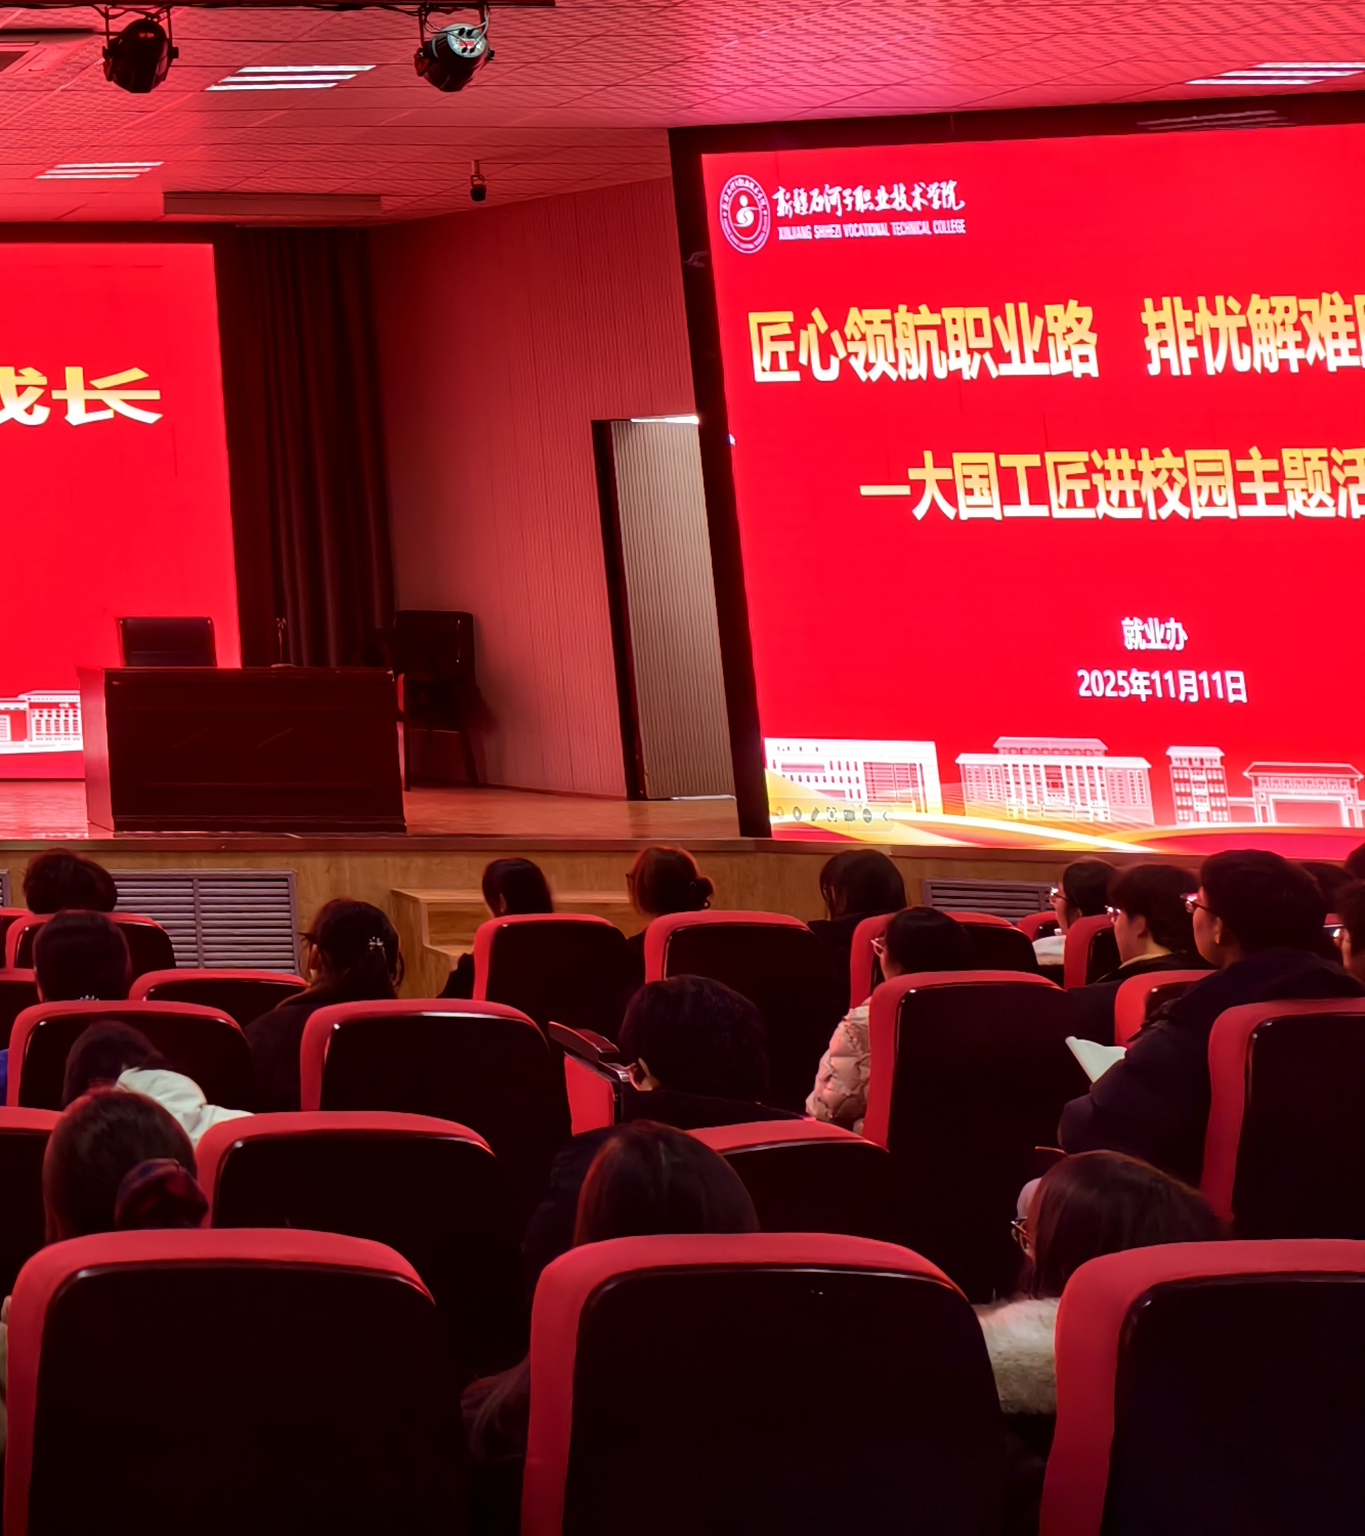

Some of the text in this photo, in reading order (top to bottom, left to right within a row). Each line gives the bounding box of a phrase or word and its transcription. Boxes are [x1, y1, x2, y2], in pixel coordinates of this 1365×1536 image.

[931, 219, 966, 234] COLLEGE
[749, 291, 1365, 382] 匠心领航职业路 排忧解难
[1121, 617, 1188, 650] 就业办
[1077, 668, 1247, 703] 2025年11月11日
